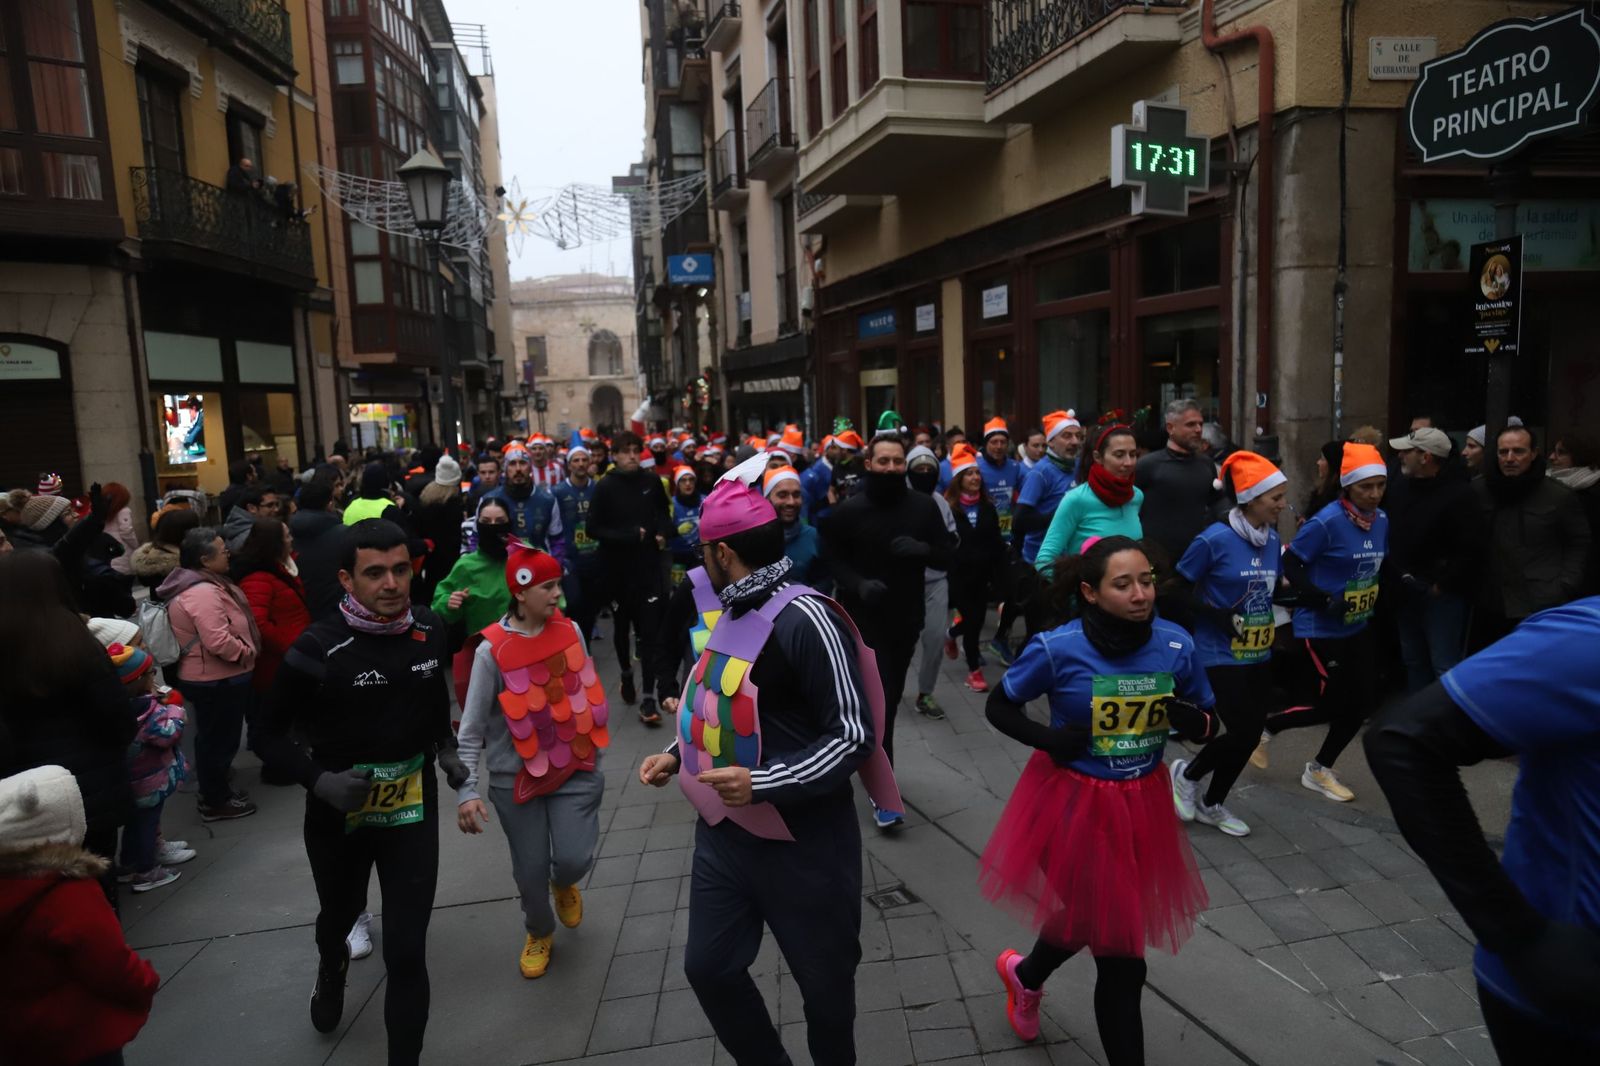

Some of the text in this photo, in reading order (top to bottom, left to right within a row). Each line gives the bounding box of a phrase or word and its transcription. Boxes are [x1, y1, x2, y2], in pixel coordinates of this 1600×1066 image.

[1393, 43, 1421, 52] CALLE
[1398, 55, 1410, 63] DE
[1373, 66, 1419, 75] QUEBRANTAHU
[1448, 44, 1551, 99] TEATRO
[1432, 82, 1569, 142] PRINCIPAL
[1131, 142, 1196, 176] 17:31
[1452, 211, 1468, 224] Un
[1527, 208, 1540, 224] la
[1542, 208, 1578, 224] salud
[517, 512, 526, 528] 5
[1363, 539, 1373, 549] 46
[1251, 557, 1262, 567] 46
[1346, 591, 1375, 613] 556
[1237, 628, 1271, 647] 413
[411, 659, 439, 672] acquire
[1117, 677, 1156, 686] FUNDACIÓN
[1099, 698, 1166, 731] 376
[1116, 735, 1163, 750] CAJA RURAL
[370, 778, 409, 808] 124
[366, 809, 419, 823] CAJA RURAL
